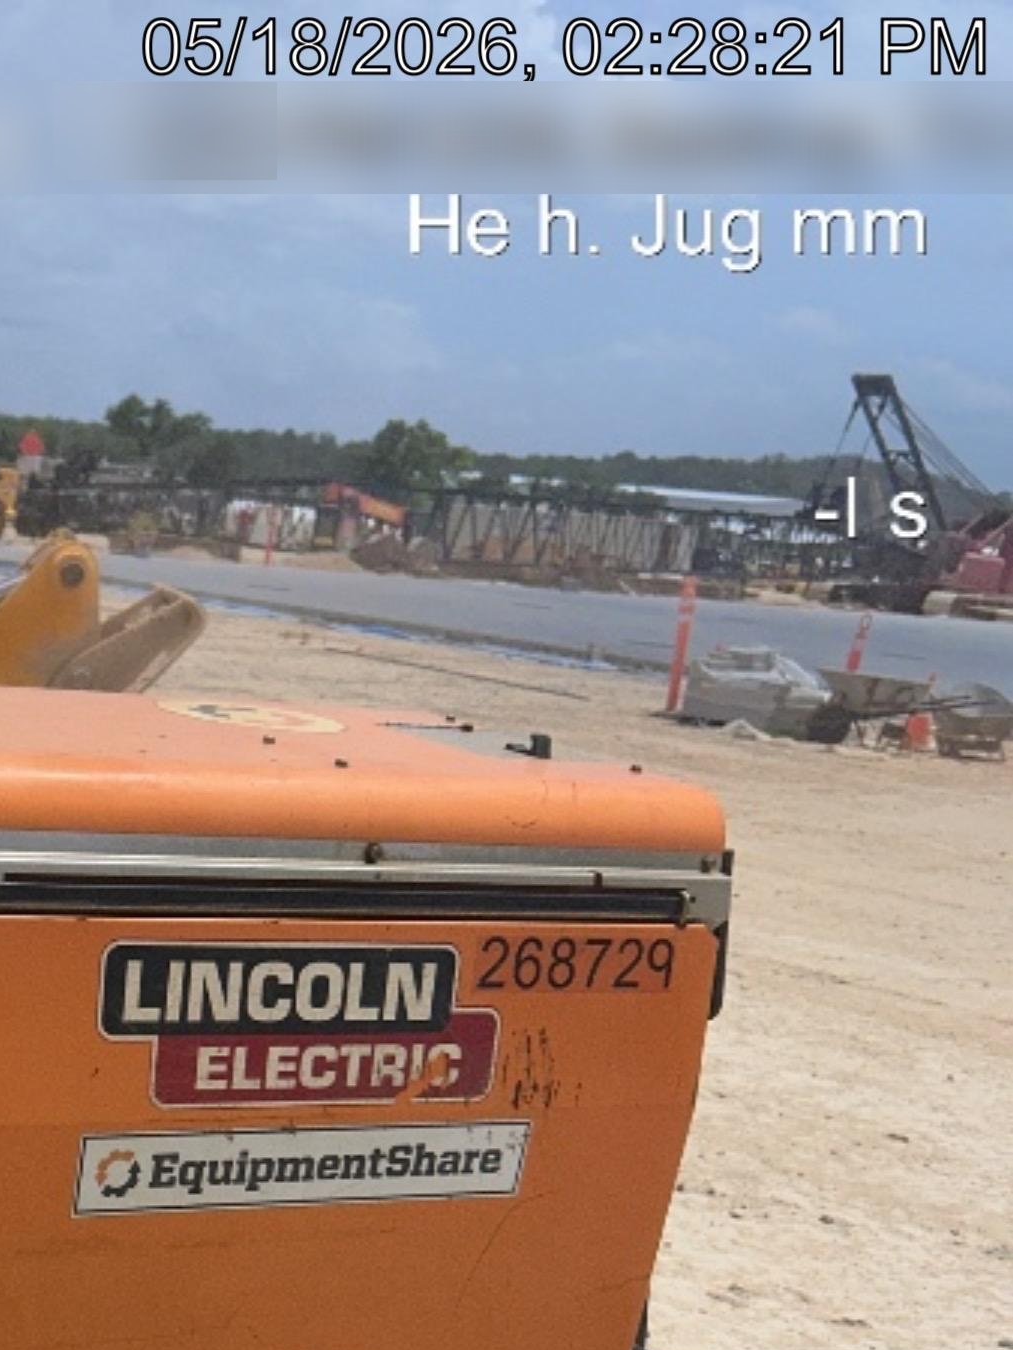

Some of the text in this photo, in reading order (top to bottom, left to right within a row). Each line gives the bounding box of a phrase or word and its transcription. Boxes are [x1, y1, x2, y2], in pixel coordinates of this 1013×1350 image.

[476, 936, 676, 989] 268729
[121, 960, 438, 1023] LINCOLN
[195, 1043, 463, 1090] ELECTRIC
[148, 1142, 502, 1196] EquipmentShare
